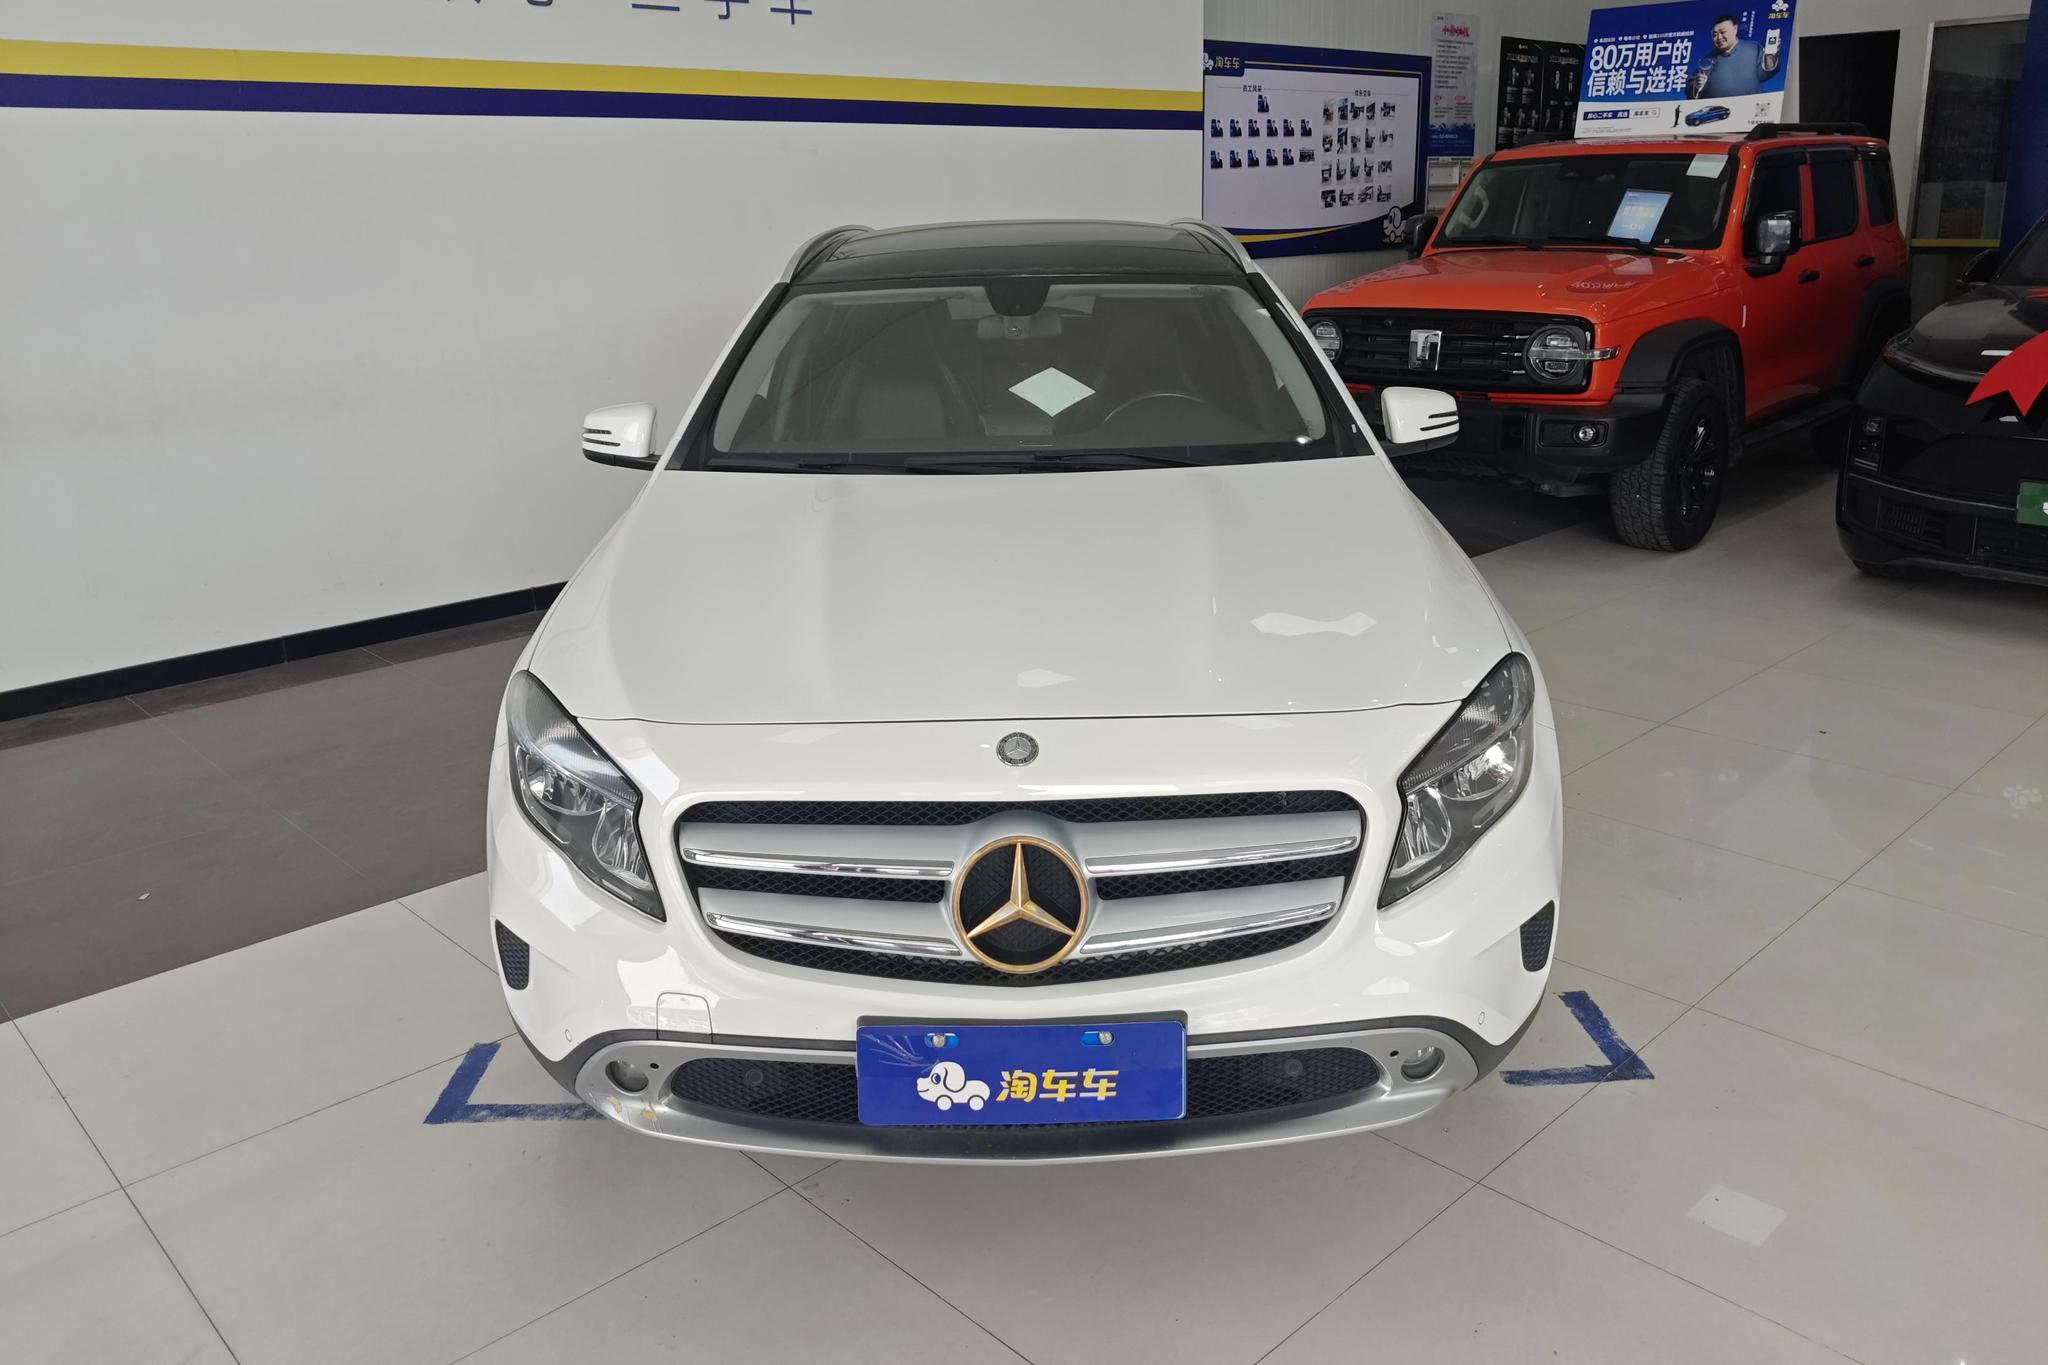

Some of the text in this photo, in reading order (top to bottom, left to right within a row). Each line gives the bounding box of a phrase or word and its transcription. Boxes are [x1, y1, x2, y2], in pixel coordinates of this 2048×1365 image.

[1215, 56, 1241, 69] 淘车车
[1589, 38, 1692, 71] 80万用户的
[1587, 65, 1688, 97] 信赖与选择
[996, 1068, 1119, 1103] 淘车车
